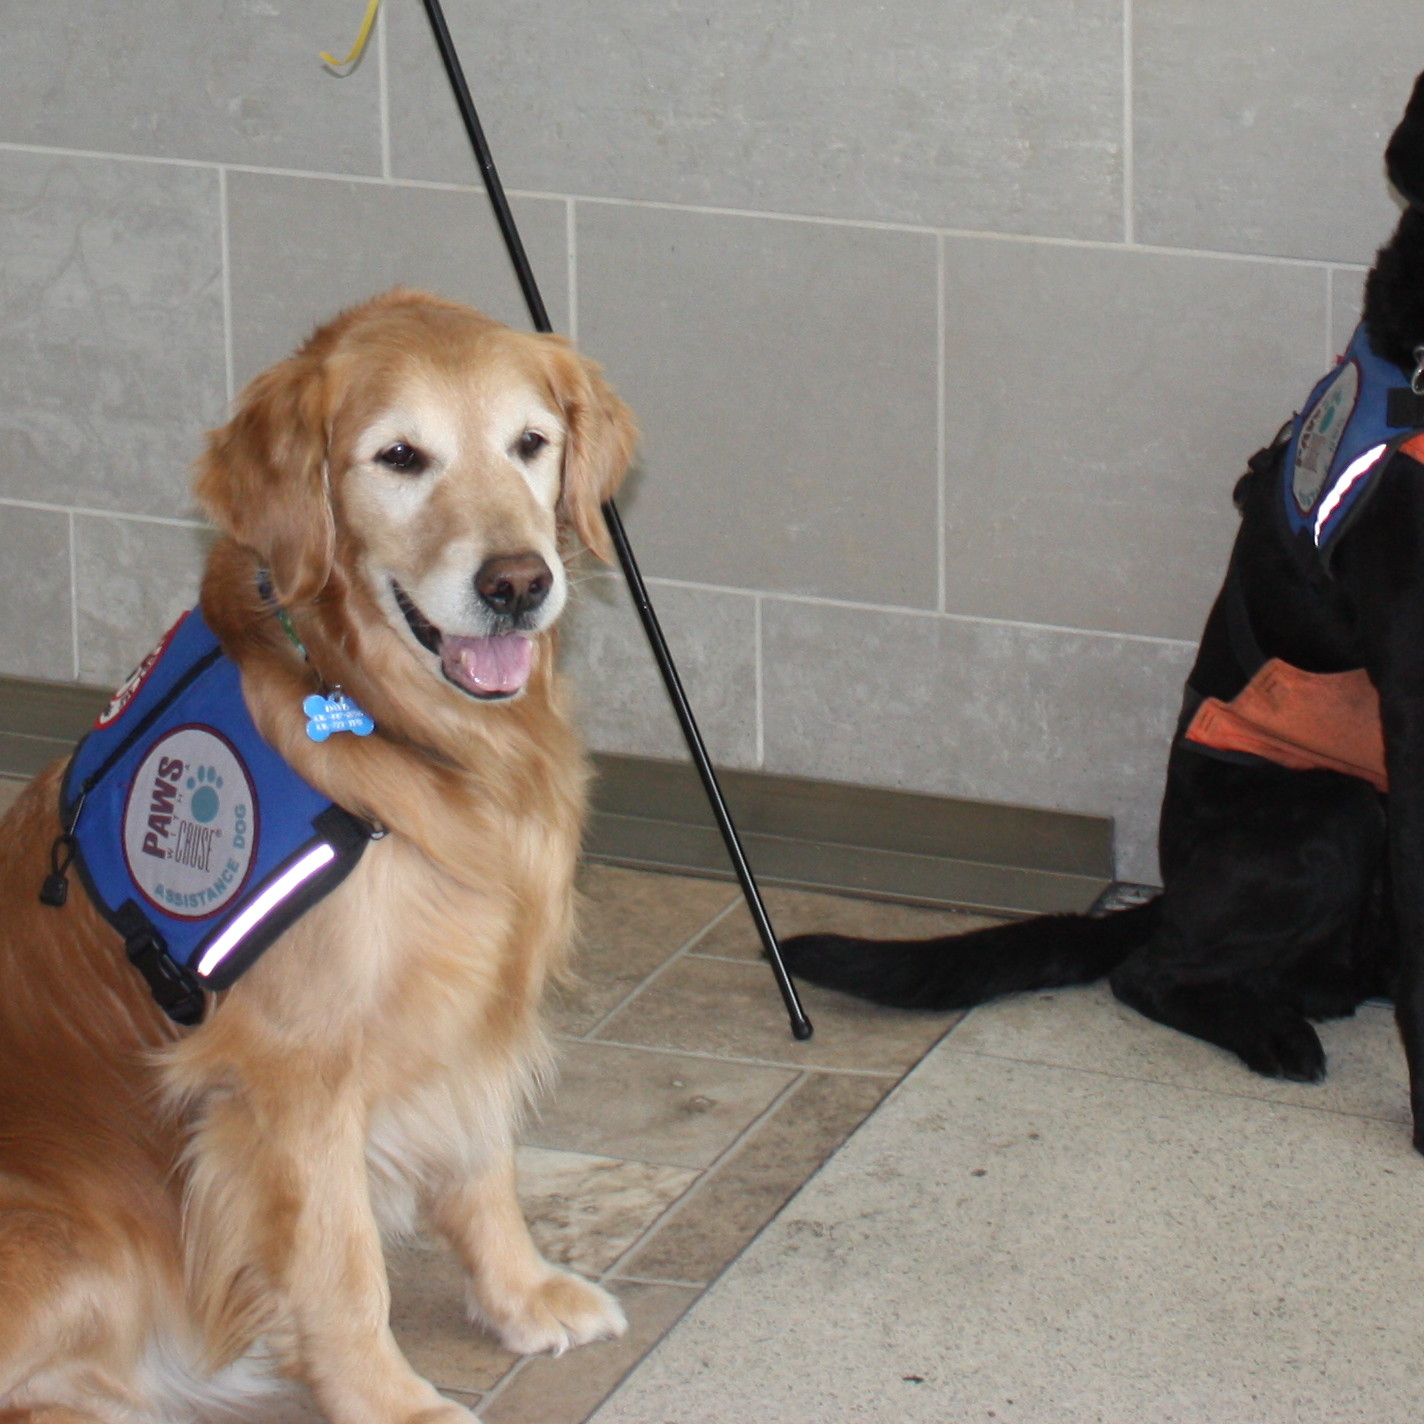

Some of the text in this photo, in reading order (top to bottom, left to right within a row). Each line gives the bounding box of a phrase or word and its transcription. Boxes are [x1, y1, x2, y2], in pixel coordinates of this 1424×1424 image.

[142, 756, 184, 860] PAWS
[154, 802, 247, 909] ASSISTANCE DOG
